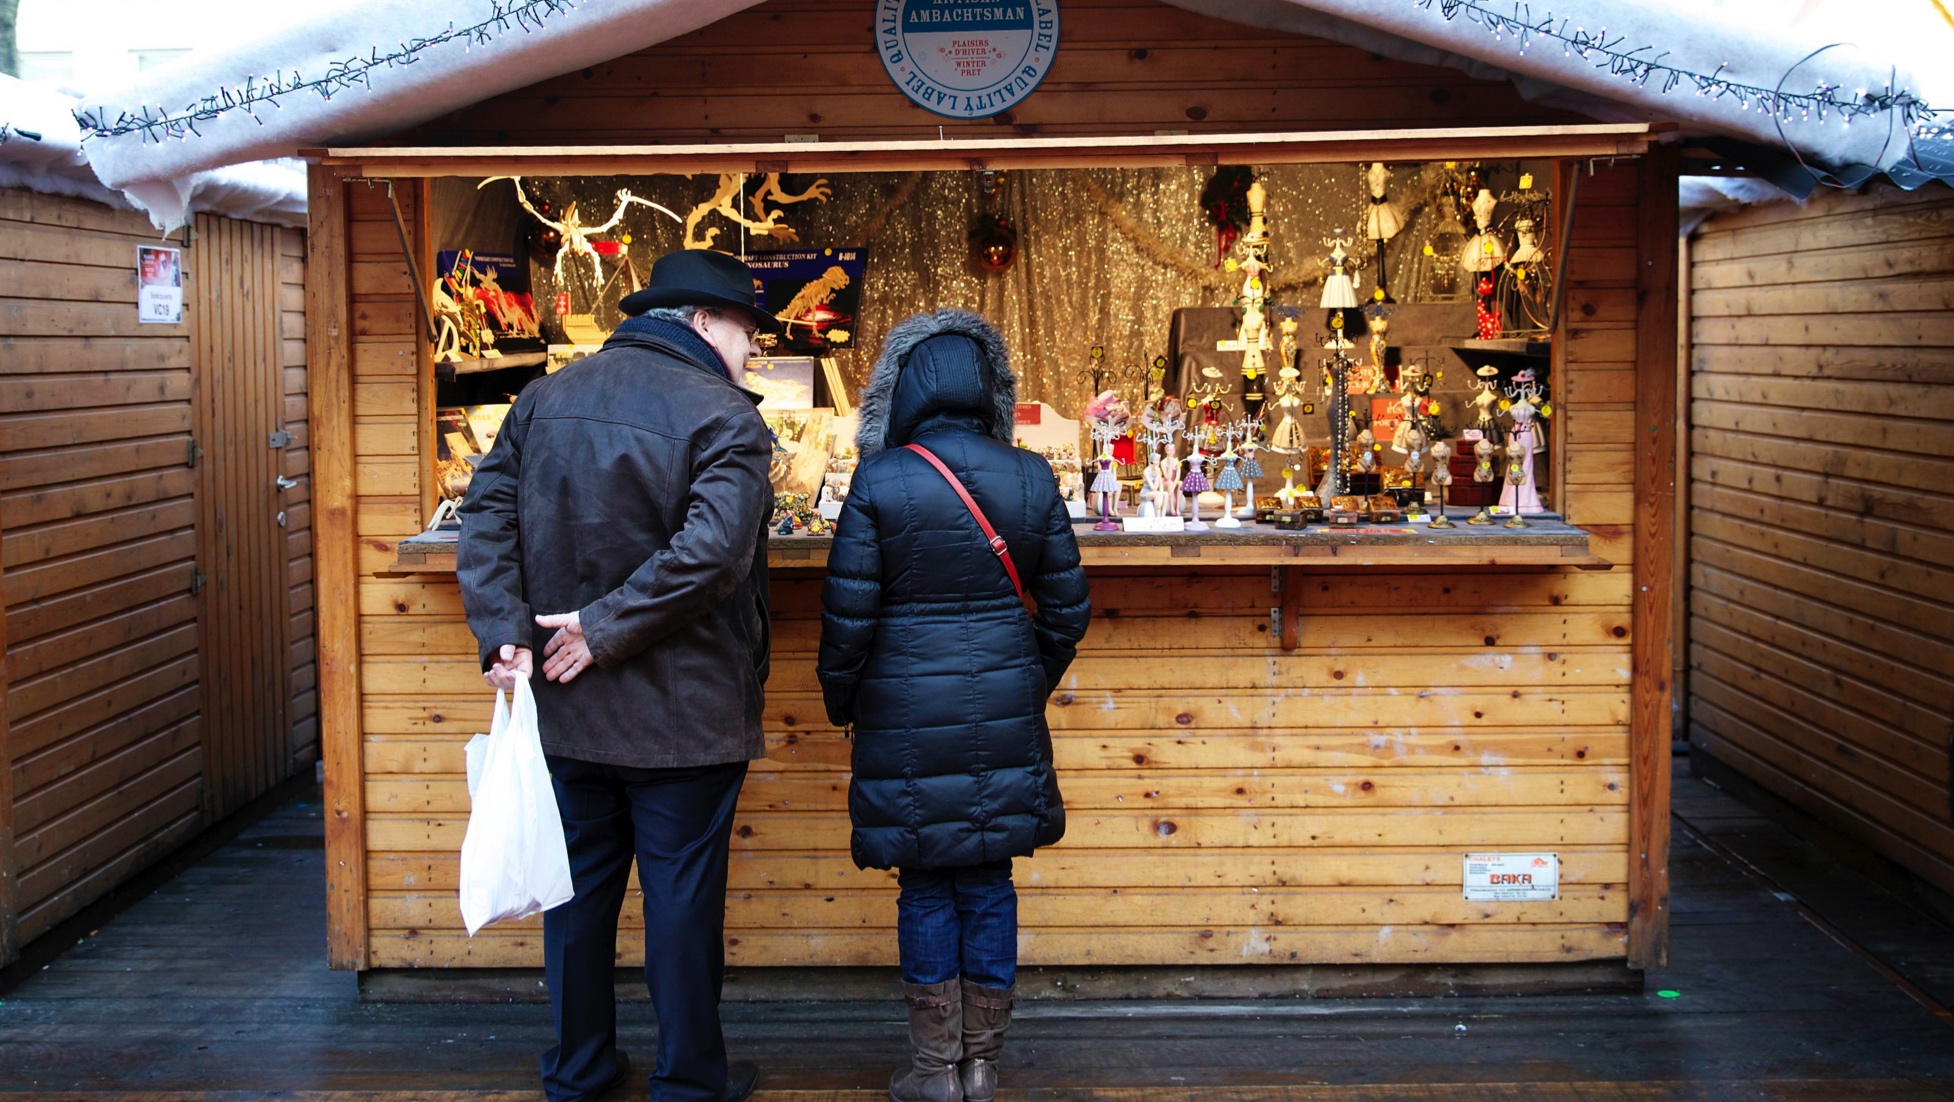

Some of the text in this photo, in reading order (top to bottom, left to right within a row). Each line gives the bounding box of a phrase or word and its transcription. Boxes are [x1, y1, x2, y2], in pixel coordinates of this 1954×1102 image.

[909, 7, 1025, 23] AMBACHTSMAN
[952, 40, 989, 48] PLAISIRS
[955, 48, 987, 56] D'HIVER
[904, 65, 1038, 112] QUALITY LABEL
[760, 253, 805, 261] CONSTRUCTION
[745, 261, 789, 269] NOSAURUS
[1489, 873, 1532, 885] BAKA
